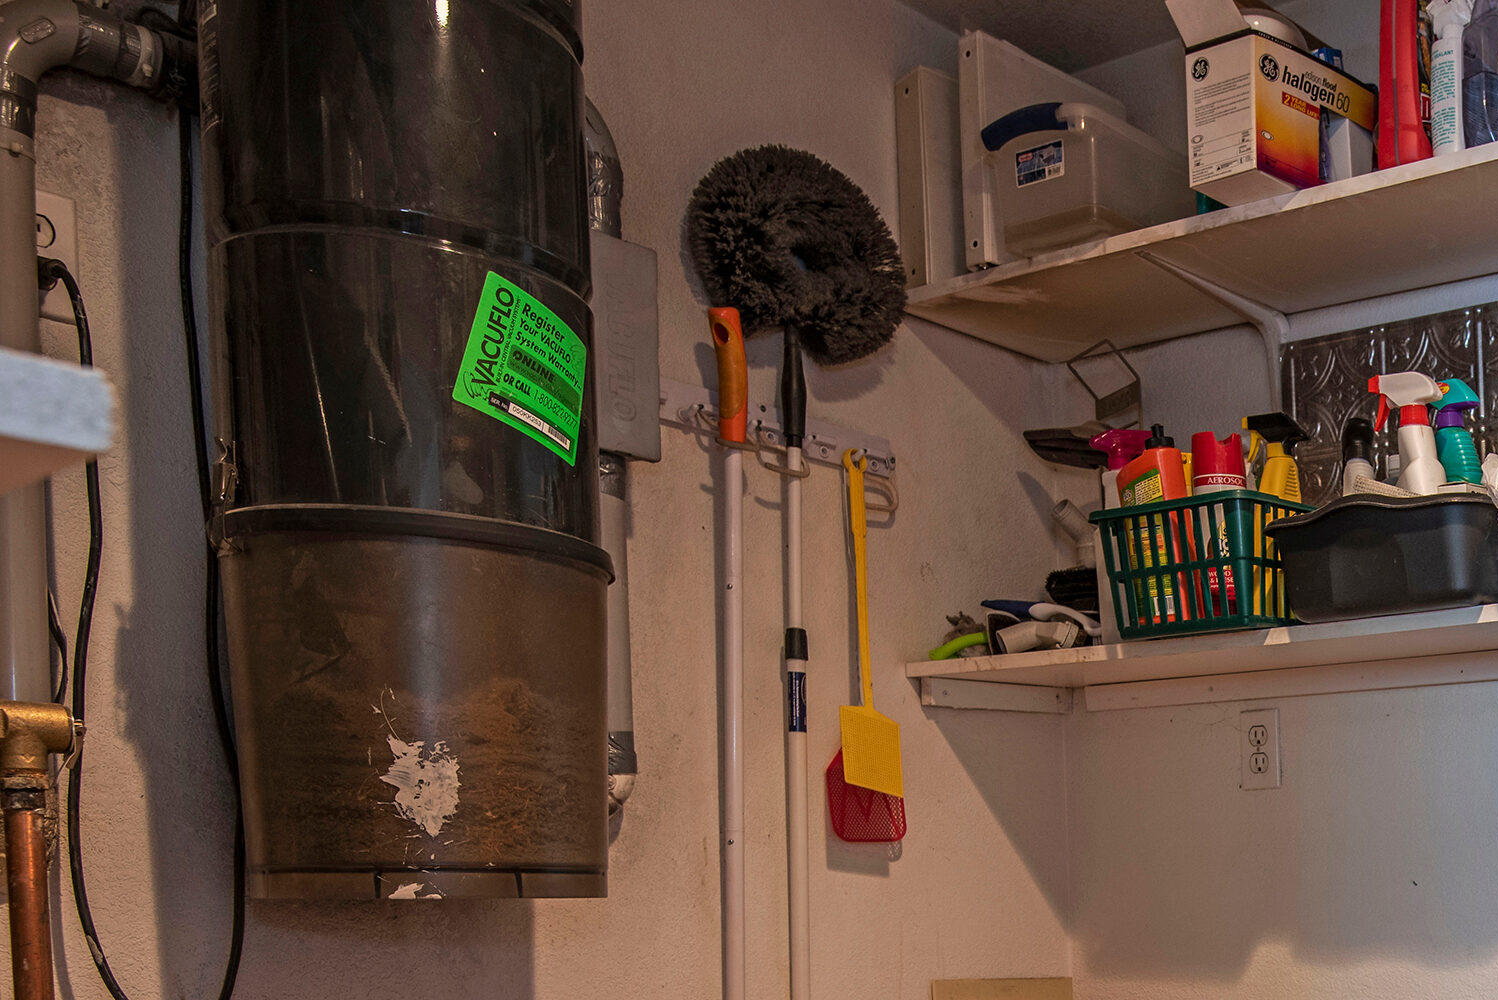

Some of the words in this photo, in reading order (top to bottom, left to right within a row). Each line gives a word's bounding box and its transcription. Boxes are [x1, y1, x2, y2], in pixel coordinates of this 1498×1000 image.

[1282, 66, 1335, 106] halogen
[1336, 92, 1350, 113] 60
[1322, 76, 1337, 92] flood
[1284, 94, 1290, 106] 2
[1291, 96, 1307, 108] YEAR
[1291, 102, 1307, 114] LONG
[522, 303, 565, 342] Register
[472, 287, 514, 386] VACUFLO
[515, 332, 546, 357] System
[520, 317, 538, 336] Your
[541, 331, 571, 364] VACUFLO
[512, 350, 555, 383] ONLINE
[503, 373, 516, 387] OR
[516, 379, 531, 396] CALL
[1207, 476, 1243, 486] AEROSOL
